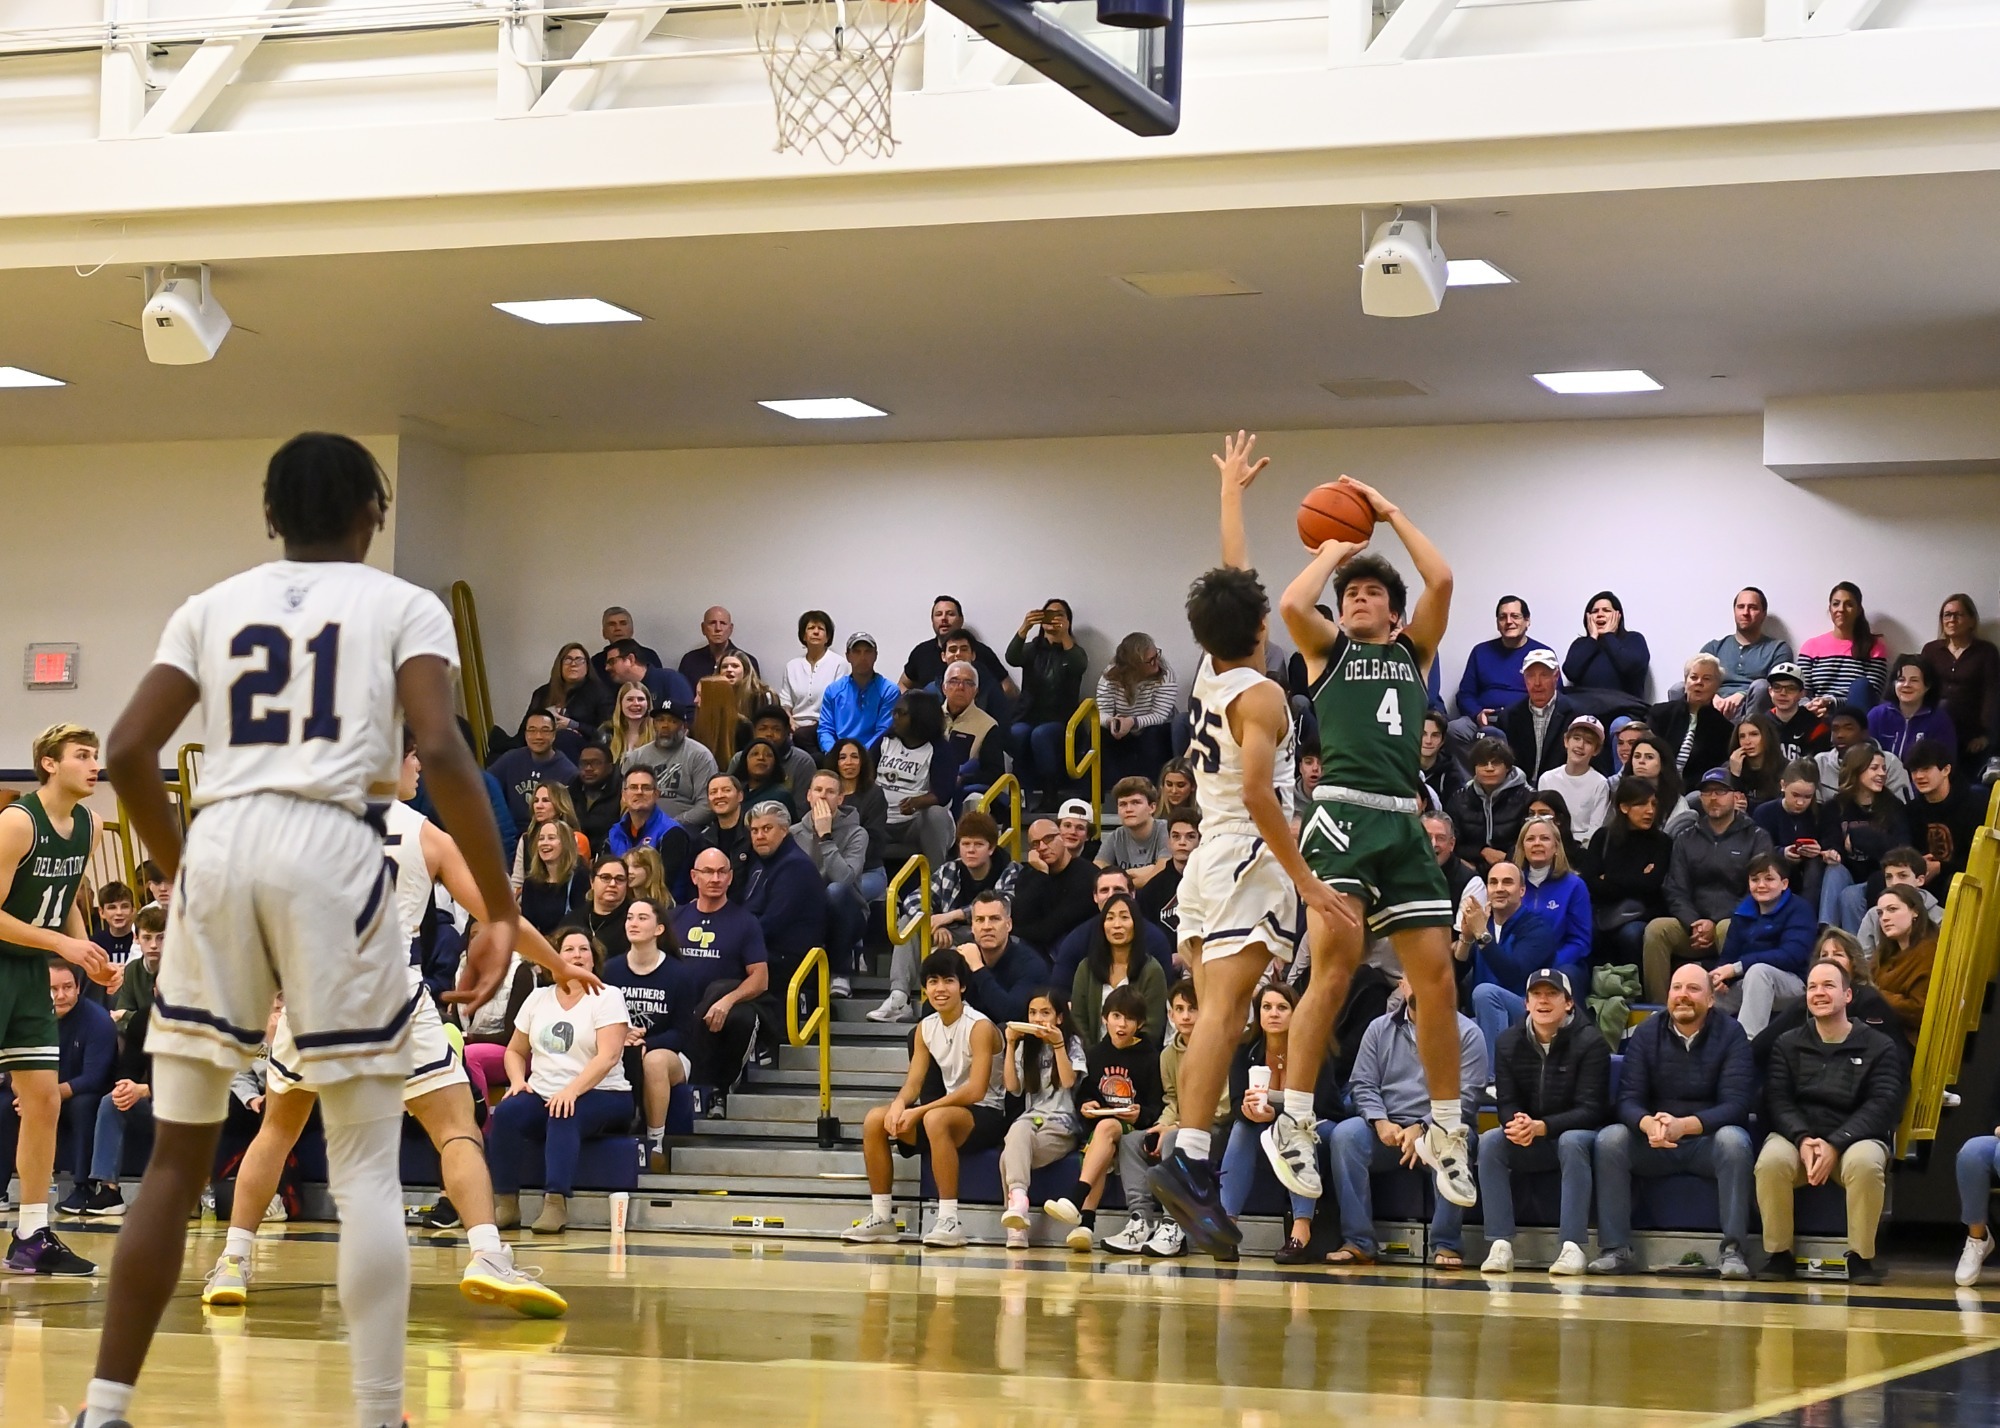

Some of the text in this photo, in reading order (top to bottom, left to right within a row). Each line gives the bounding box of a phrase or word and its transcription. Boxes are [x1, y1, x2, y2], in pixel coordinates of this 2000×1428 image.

[229, 622, 342, 747] 21
[1376, 688, 1402, 736] 4
[880, 755, 921, 776] RATORY
[32, 856, 85, 877] DELBATON
[31, 885, 68, 927] 11
[687, 926, 716, 948] OP
[621, 986, 666, 1001] PANTHERS
[626, 1000, 669, 1014] SKETBALL
